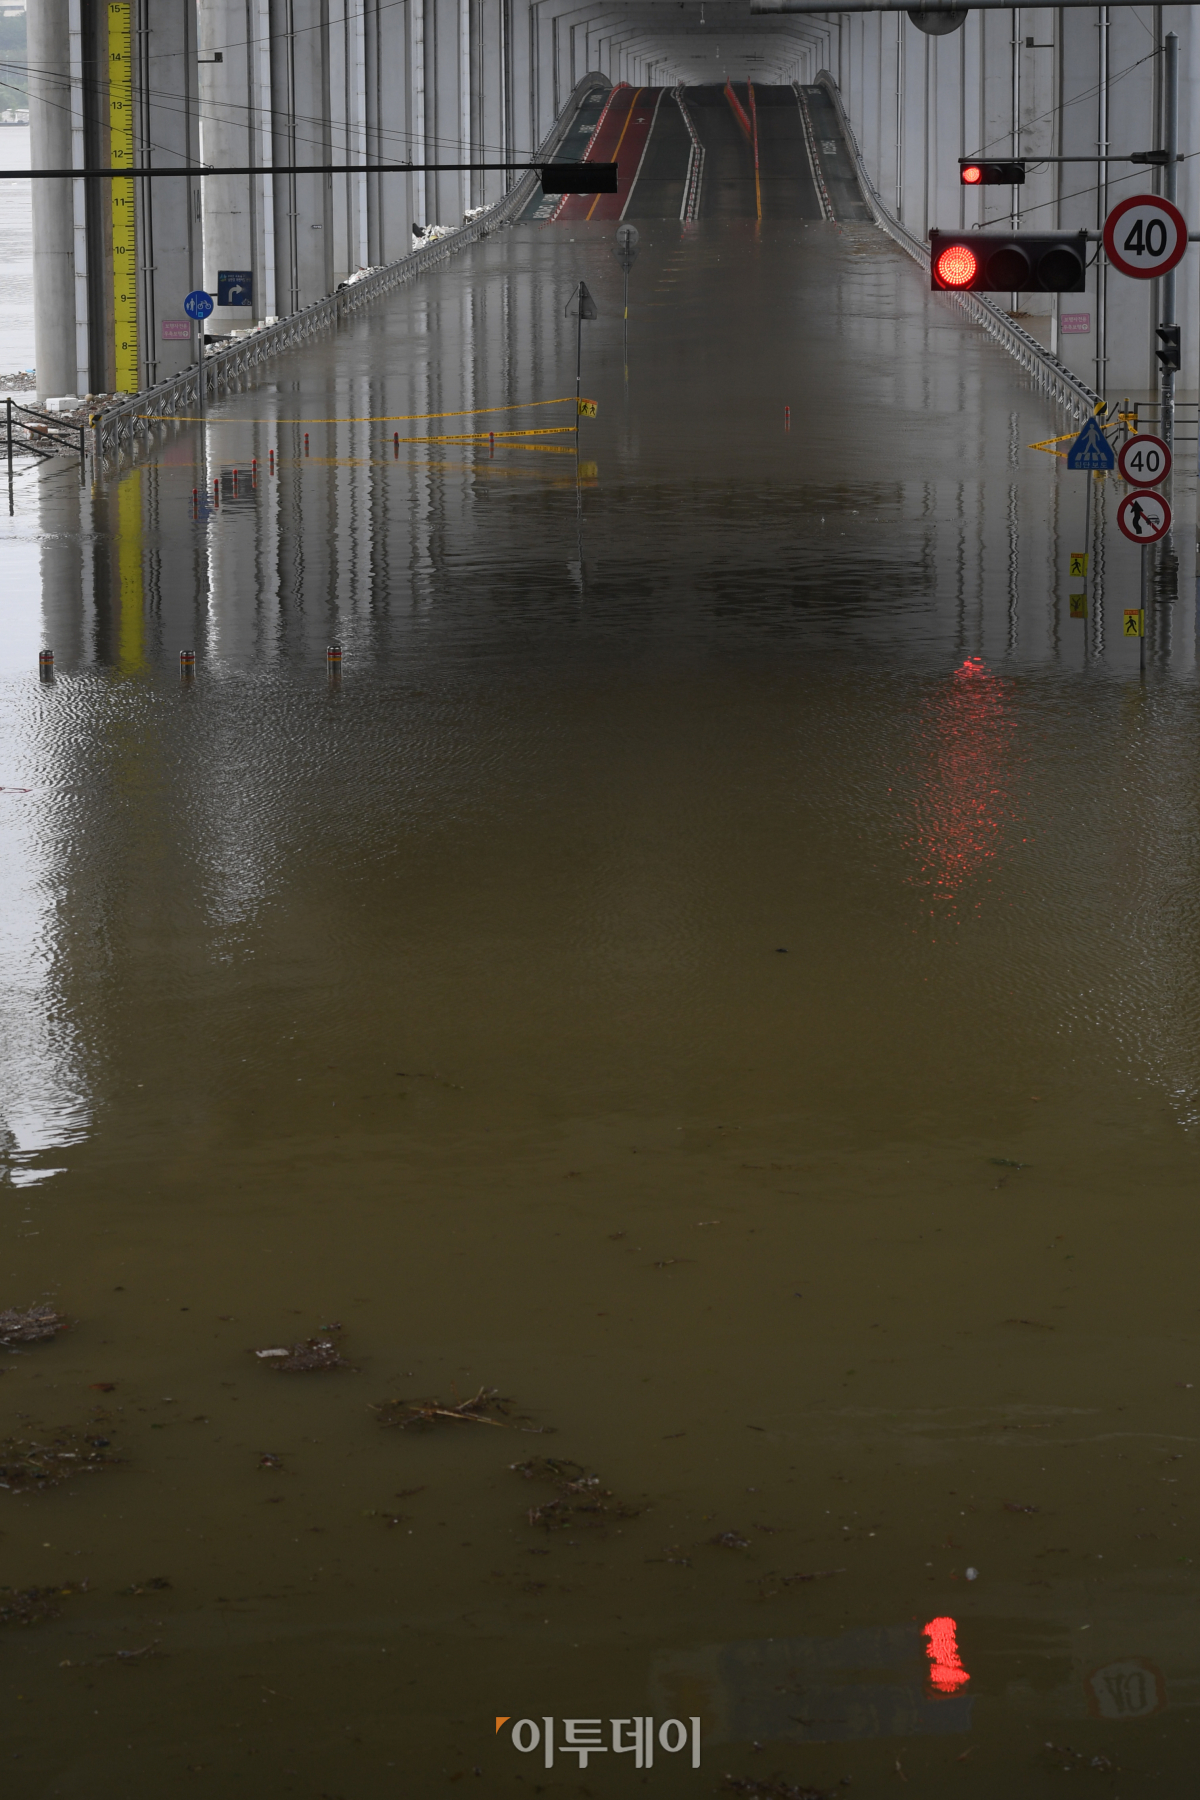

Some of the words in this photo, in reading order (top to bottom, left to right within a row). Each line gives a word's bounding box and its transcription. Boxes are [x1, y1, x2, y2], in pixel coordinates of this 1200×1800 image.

[111, 53, 121, 61] 14
[113, 150, 123, 158] 12
[114, 198, 124, 206] 11
[1124, 219, 1167, 257] 40
[115, 246, 125, 254] 10
[122, 342, 128, 350] 8
[1130, 451, 1160, 472] 40
